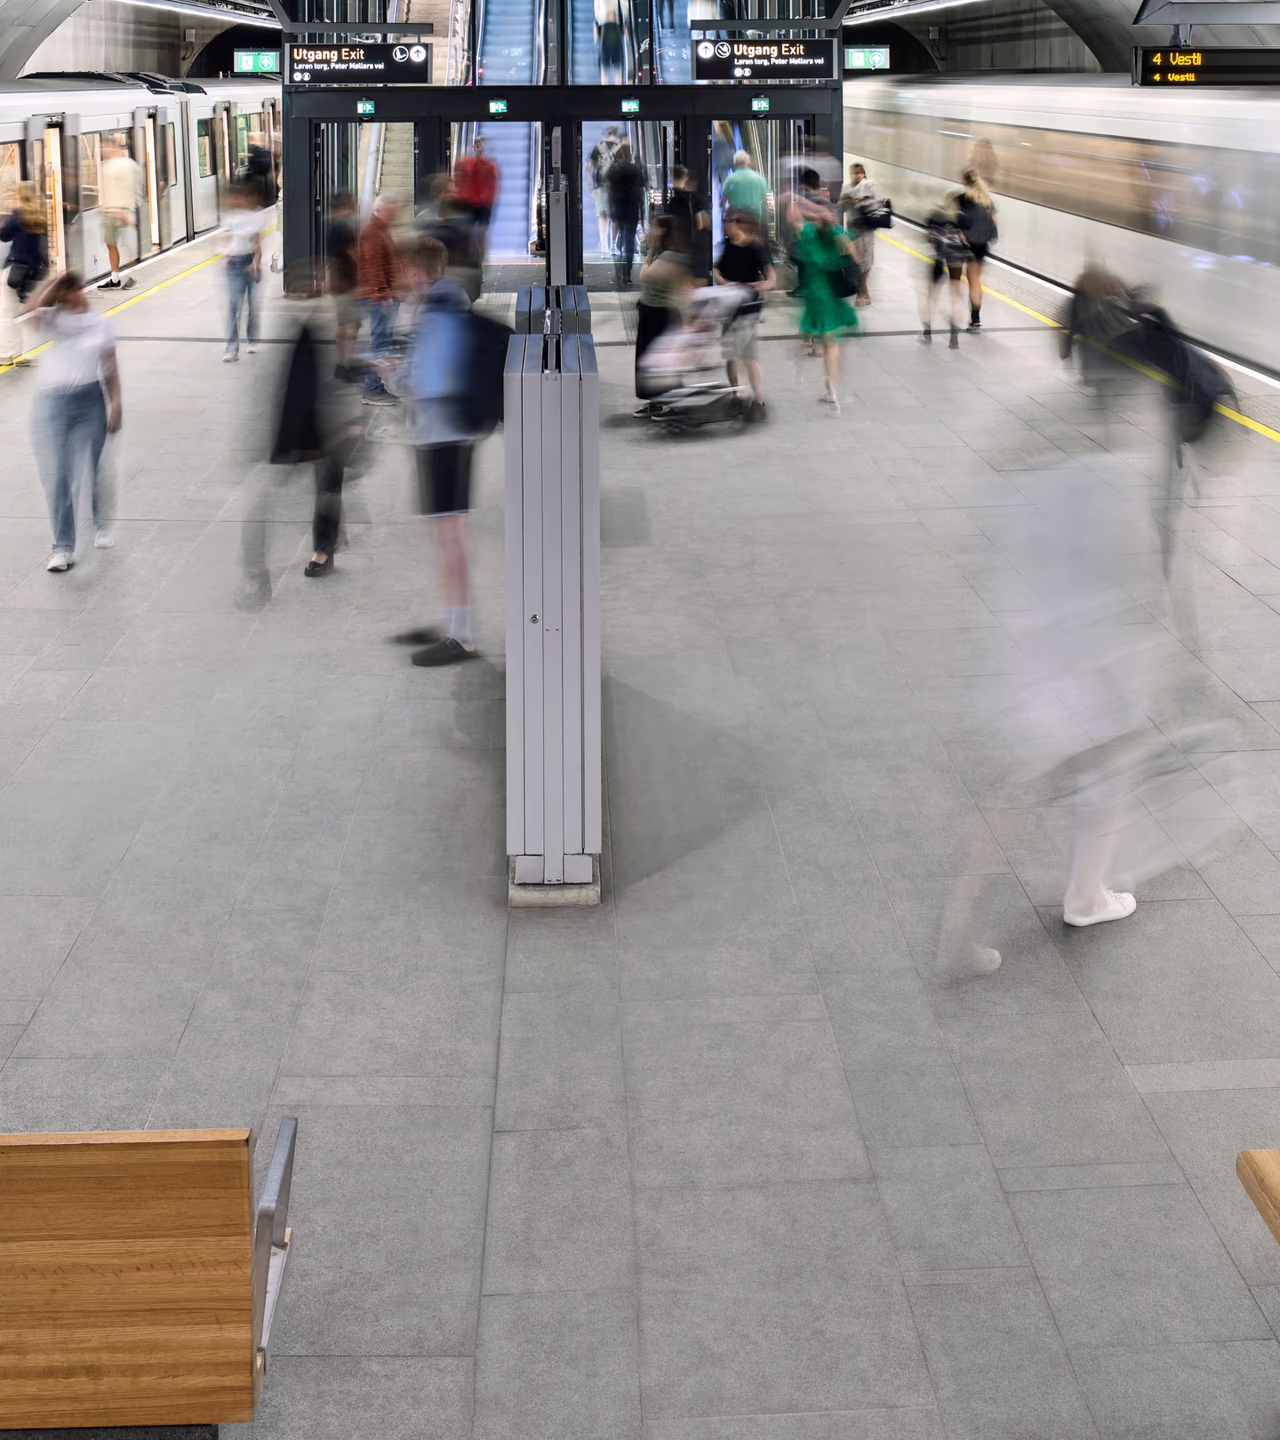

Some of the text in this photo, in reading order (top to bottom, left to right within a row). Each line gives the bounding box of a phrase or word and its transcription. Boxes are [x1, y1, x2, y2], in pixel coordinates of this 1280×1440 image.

[293, 48, 365, 62] Utgang Exit
[733, 44, 805, 58] Utgang Exit
[330, 62, 348, 70] Peter
[1152, 53, 1162, 66] 4
[1153, 73, 1161, 81] 4
